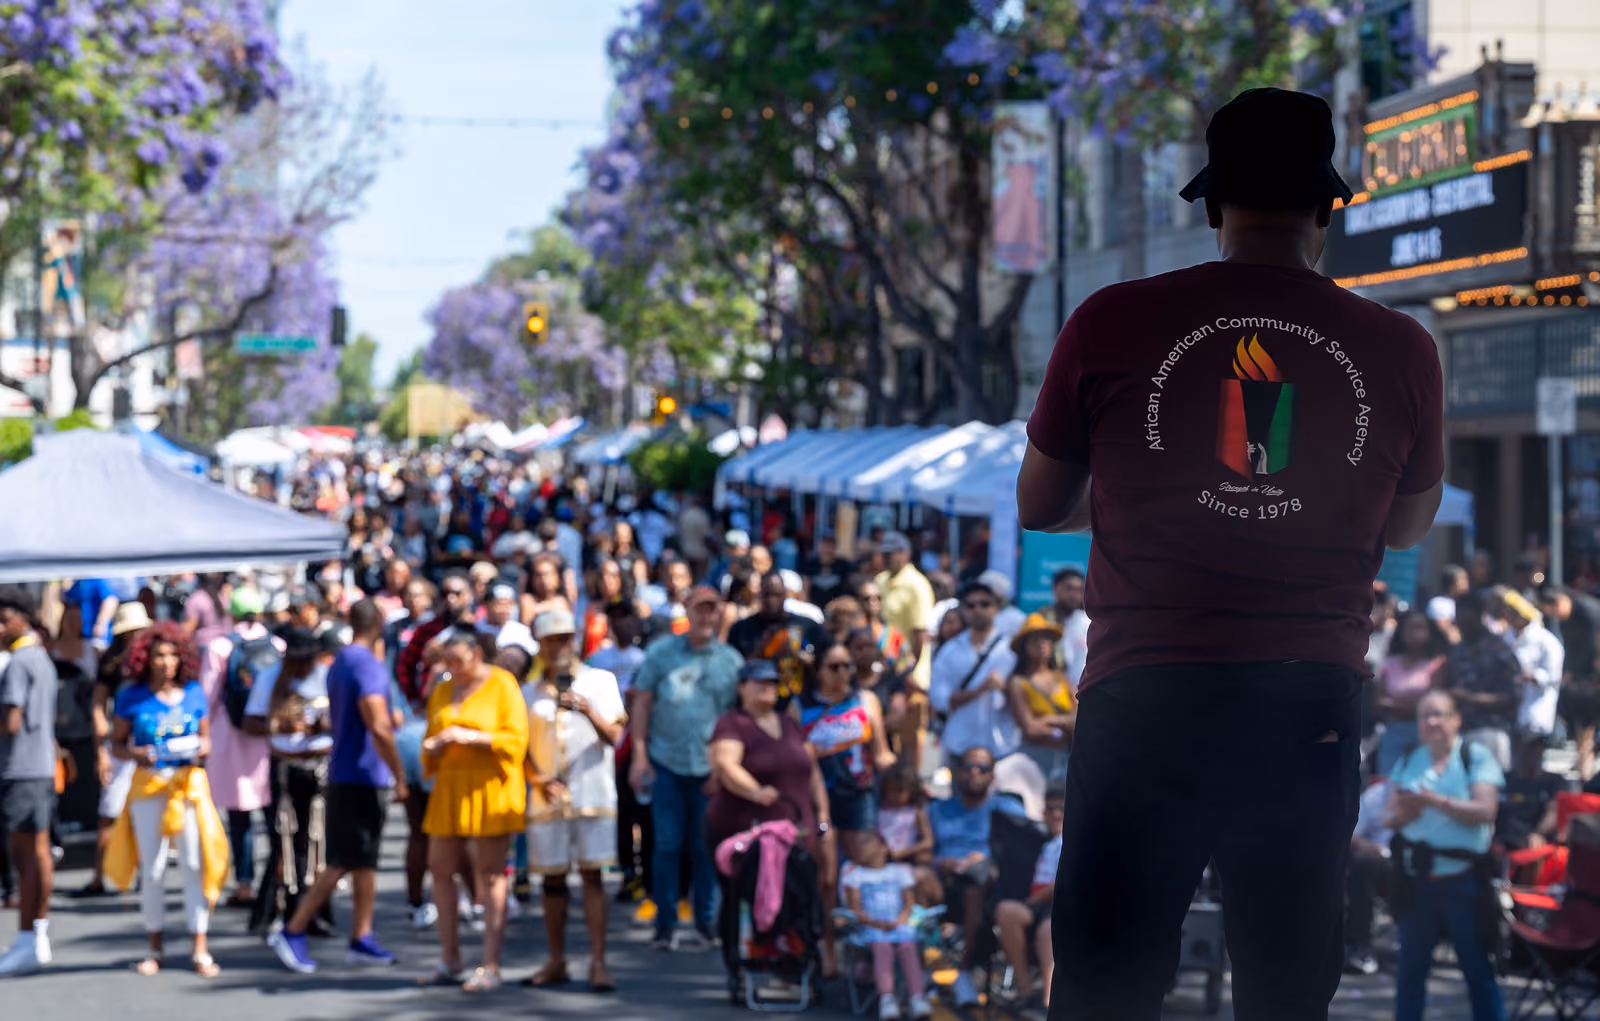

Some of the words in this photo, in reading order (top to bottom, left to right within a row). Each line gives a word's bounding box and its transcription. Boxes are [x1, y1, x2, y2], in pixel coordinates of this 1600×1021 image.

[1151, 324, 1215, 390] American
[1215, 316, 1326, 345] Community
[1325, 340, 1366, 399] Service
[1144, 392, 1165, 451] African
[1346, 403, 1372, 467] Agency
[1197, 490, 1250, 518] Since
[1257, 498, 1302, 520] 1978
[1260, 484, 1285, 497] Unity
